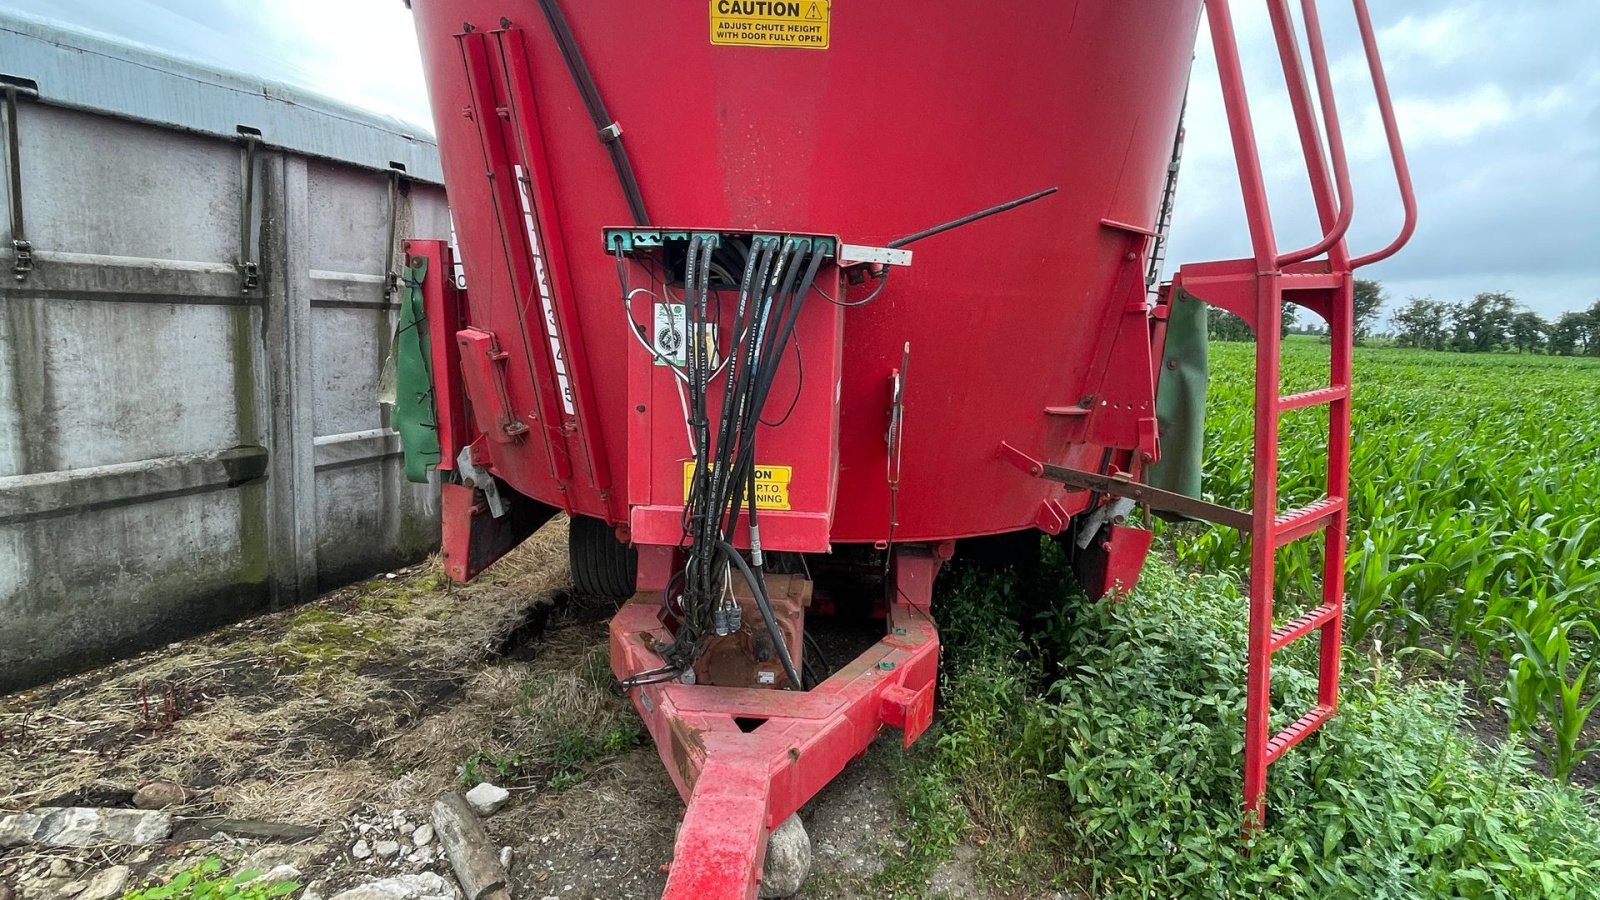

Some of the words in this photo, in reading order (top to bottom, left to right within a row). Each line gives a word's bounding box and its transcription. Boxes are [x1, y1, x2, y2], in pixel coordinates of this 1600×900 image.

[718, 0, 799, 17] CAUTION
[718, 22, 753, 31] ADJUST
[755, 23, 785, 32] CHUTE
[787, 25, 821, 33] HEIGHT
[717, 31, 738, 39] WITH
[741, 32, 766, 40] DOOR
[769, 33, 795, 42] FULLY
[798, 34, 822, 42] OPEN
